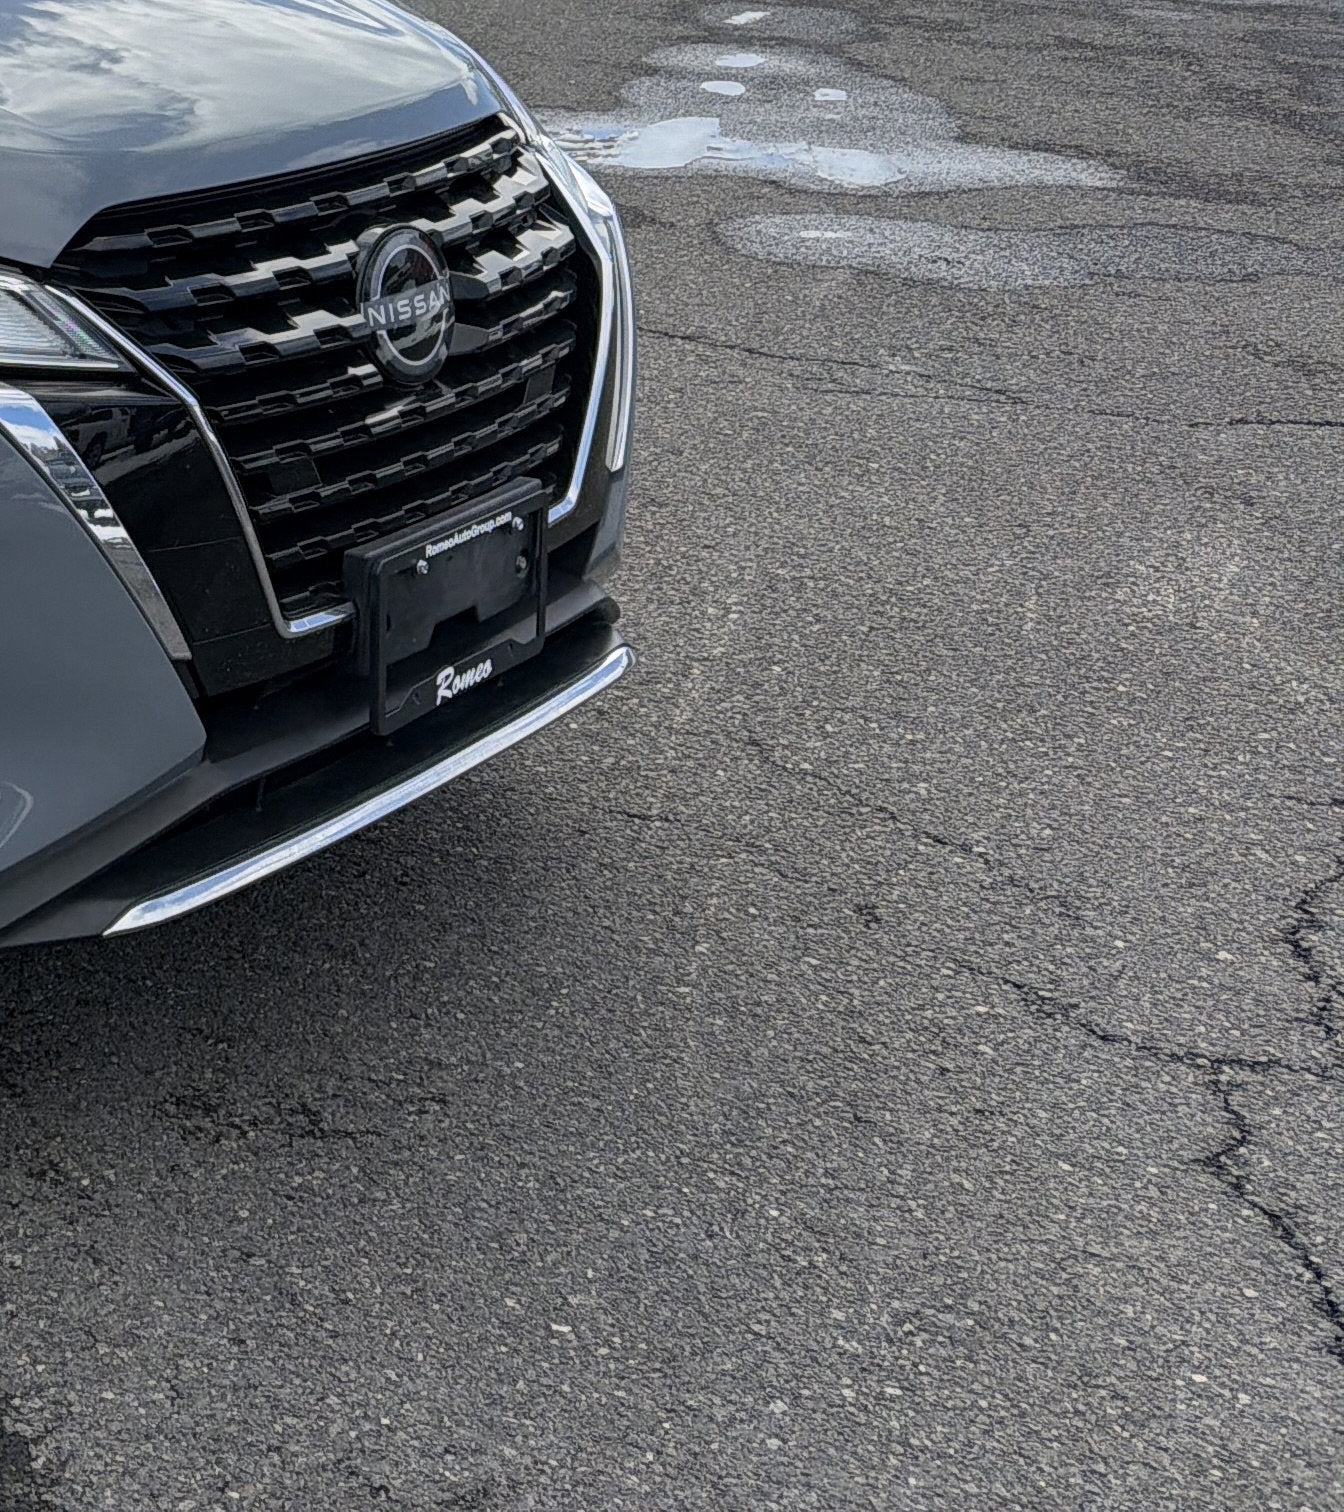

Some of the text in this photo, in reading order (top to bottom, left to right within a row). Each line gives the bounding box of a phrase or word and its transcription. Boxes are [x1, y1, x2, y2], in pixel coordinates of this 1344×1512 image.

[367, 281, 451, 328] NISSAN
[425, 511, 512, 558] RomeoAutoGroup.com
[436, 658, 493, 707] Romeo
